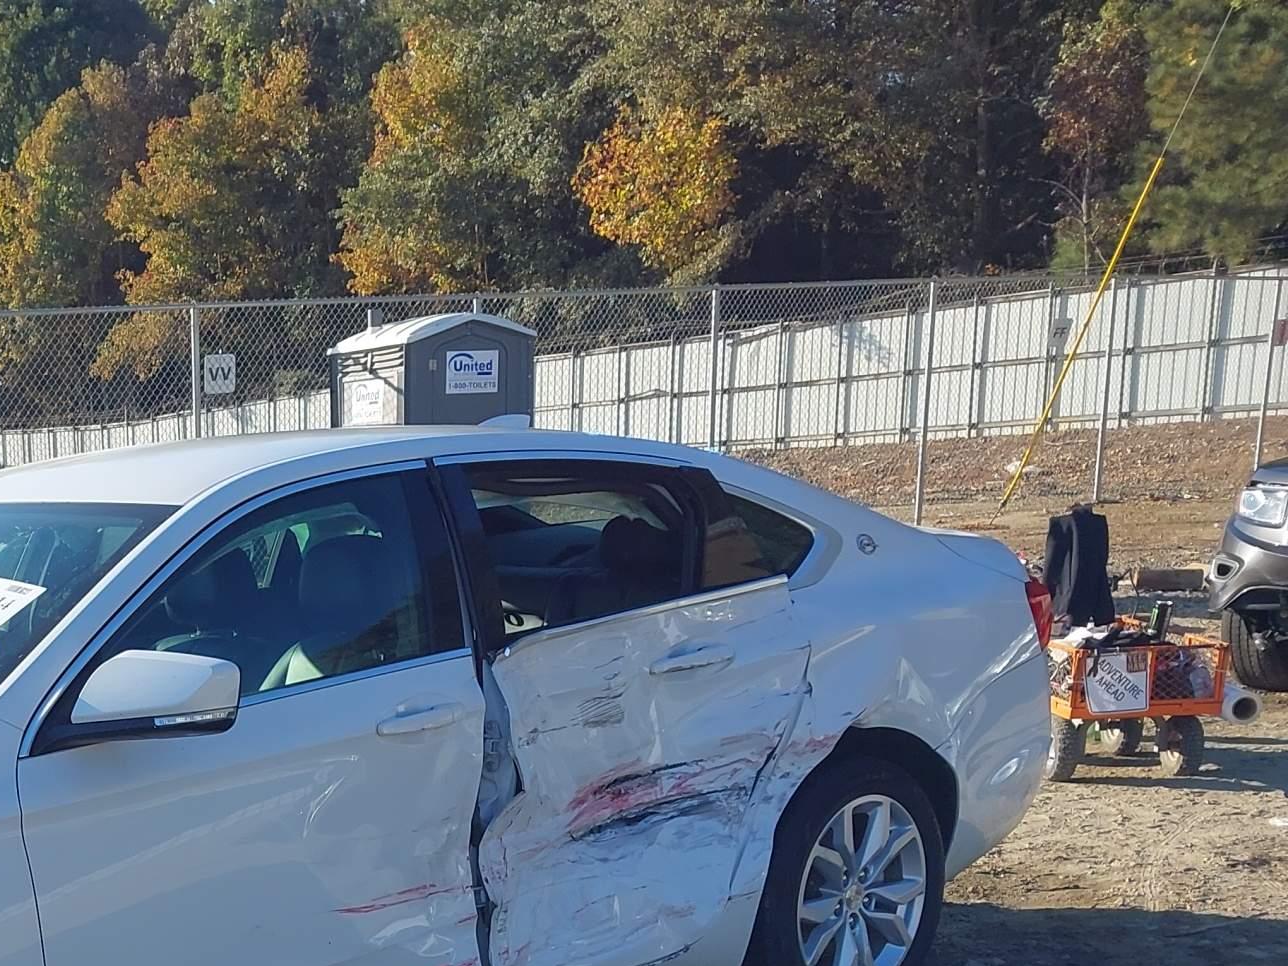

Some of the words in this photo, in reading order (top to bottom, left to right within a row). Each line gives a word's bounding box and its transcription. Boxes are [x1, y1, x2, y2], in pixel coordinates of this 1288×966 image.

[453, 359, 493, 372] United
[448, 381, 497, 390] 1-800-TOILETS
[1098, 658, 1144, 700] ADVENTURE
[1095, 676, 1126, 702] AHEAD
